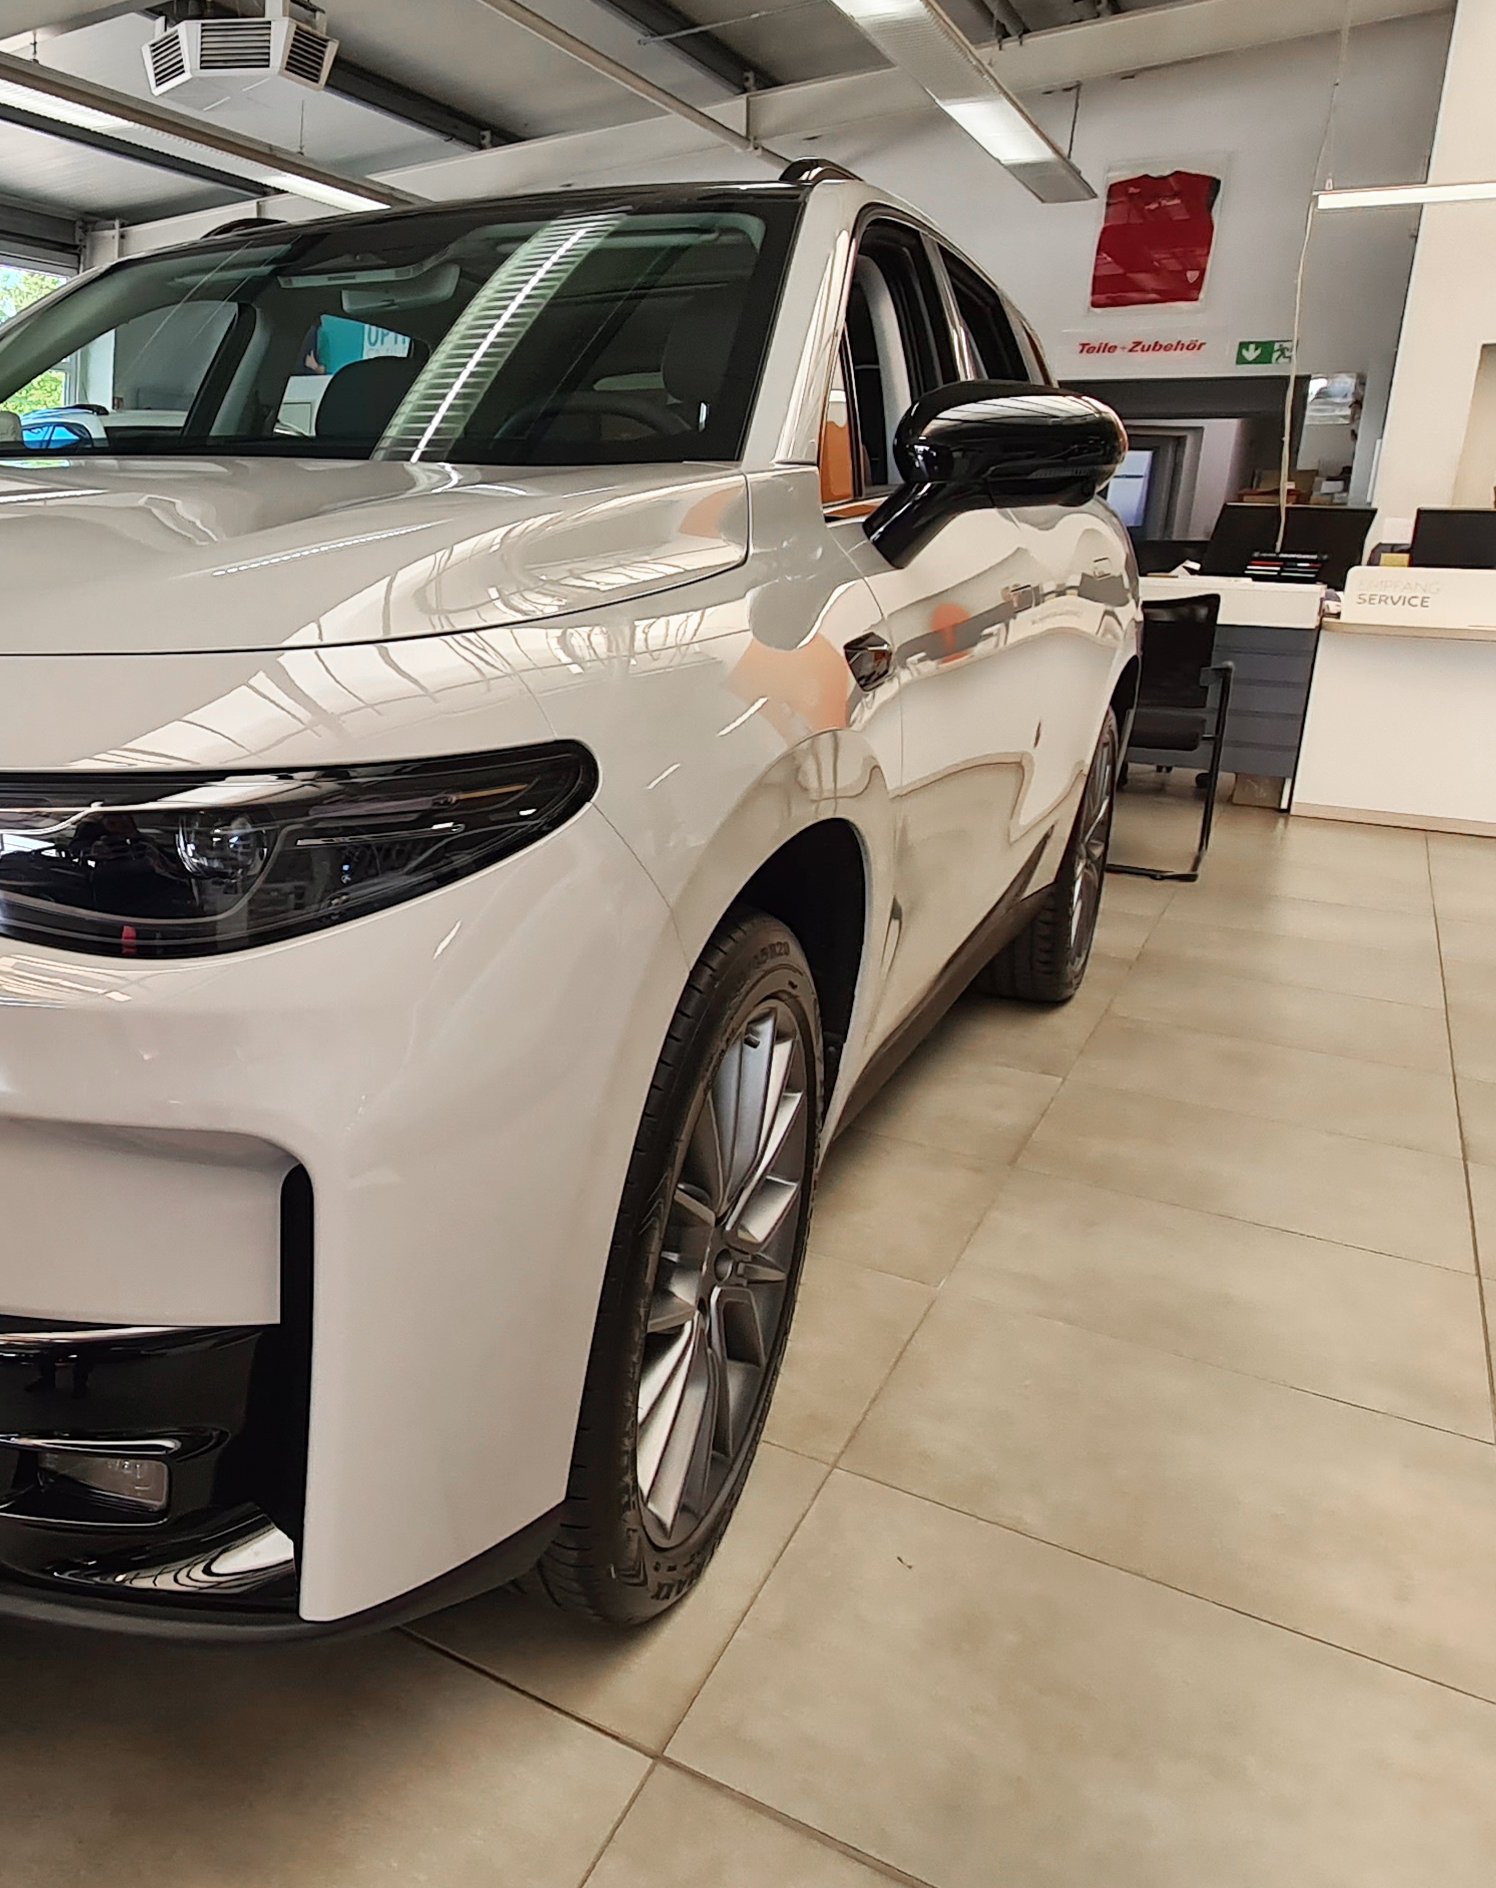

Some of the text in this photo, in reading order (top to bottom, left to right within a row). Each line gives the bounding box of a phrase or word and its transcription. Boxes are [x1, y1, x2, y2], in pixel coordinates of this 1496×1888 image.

[1078, 342, 1118, 355] Teile
[1128, 339, 1207, 353] Zubehör
[1356, 592, 1431, 608] SERVICE
